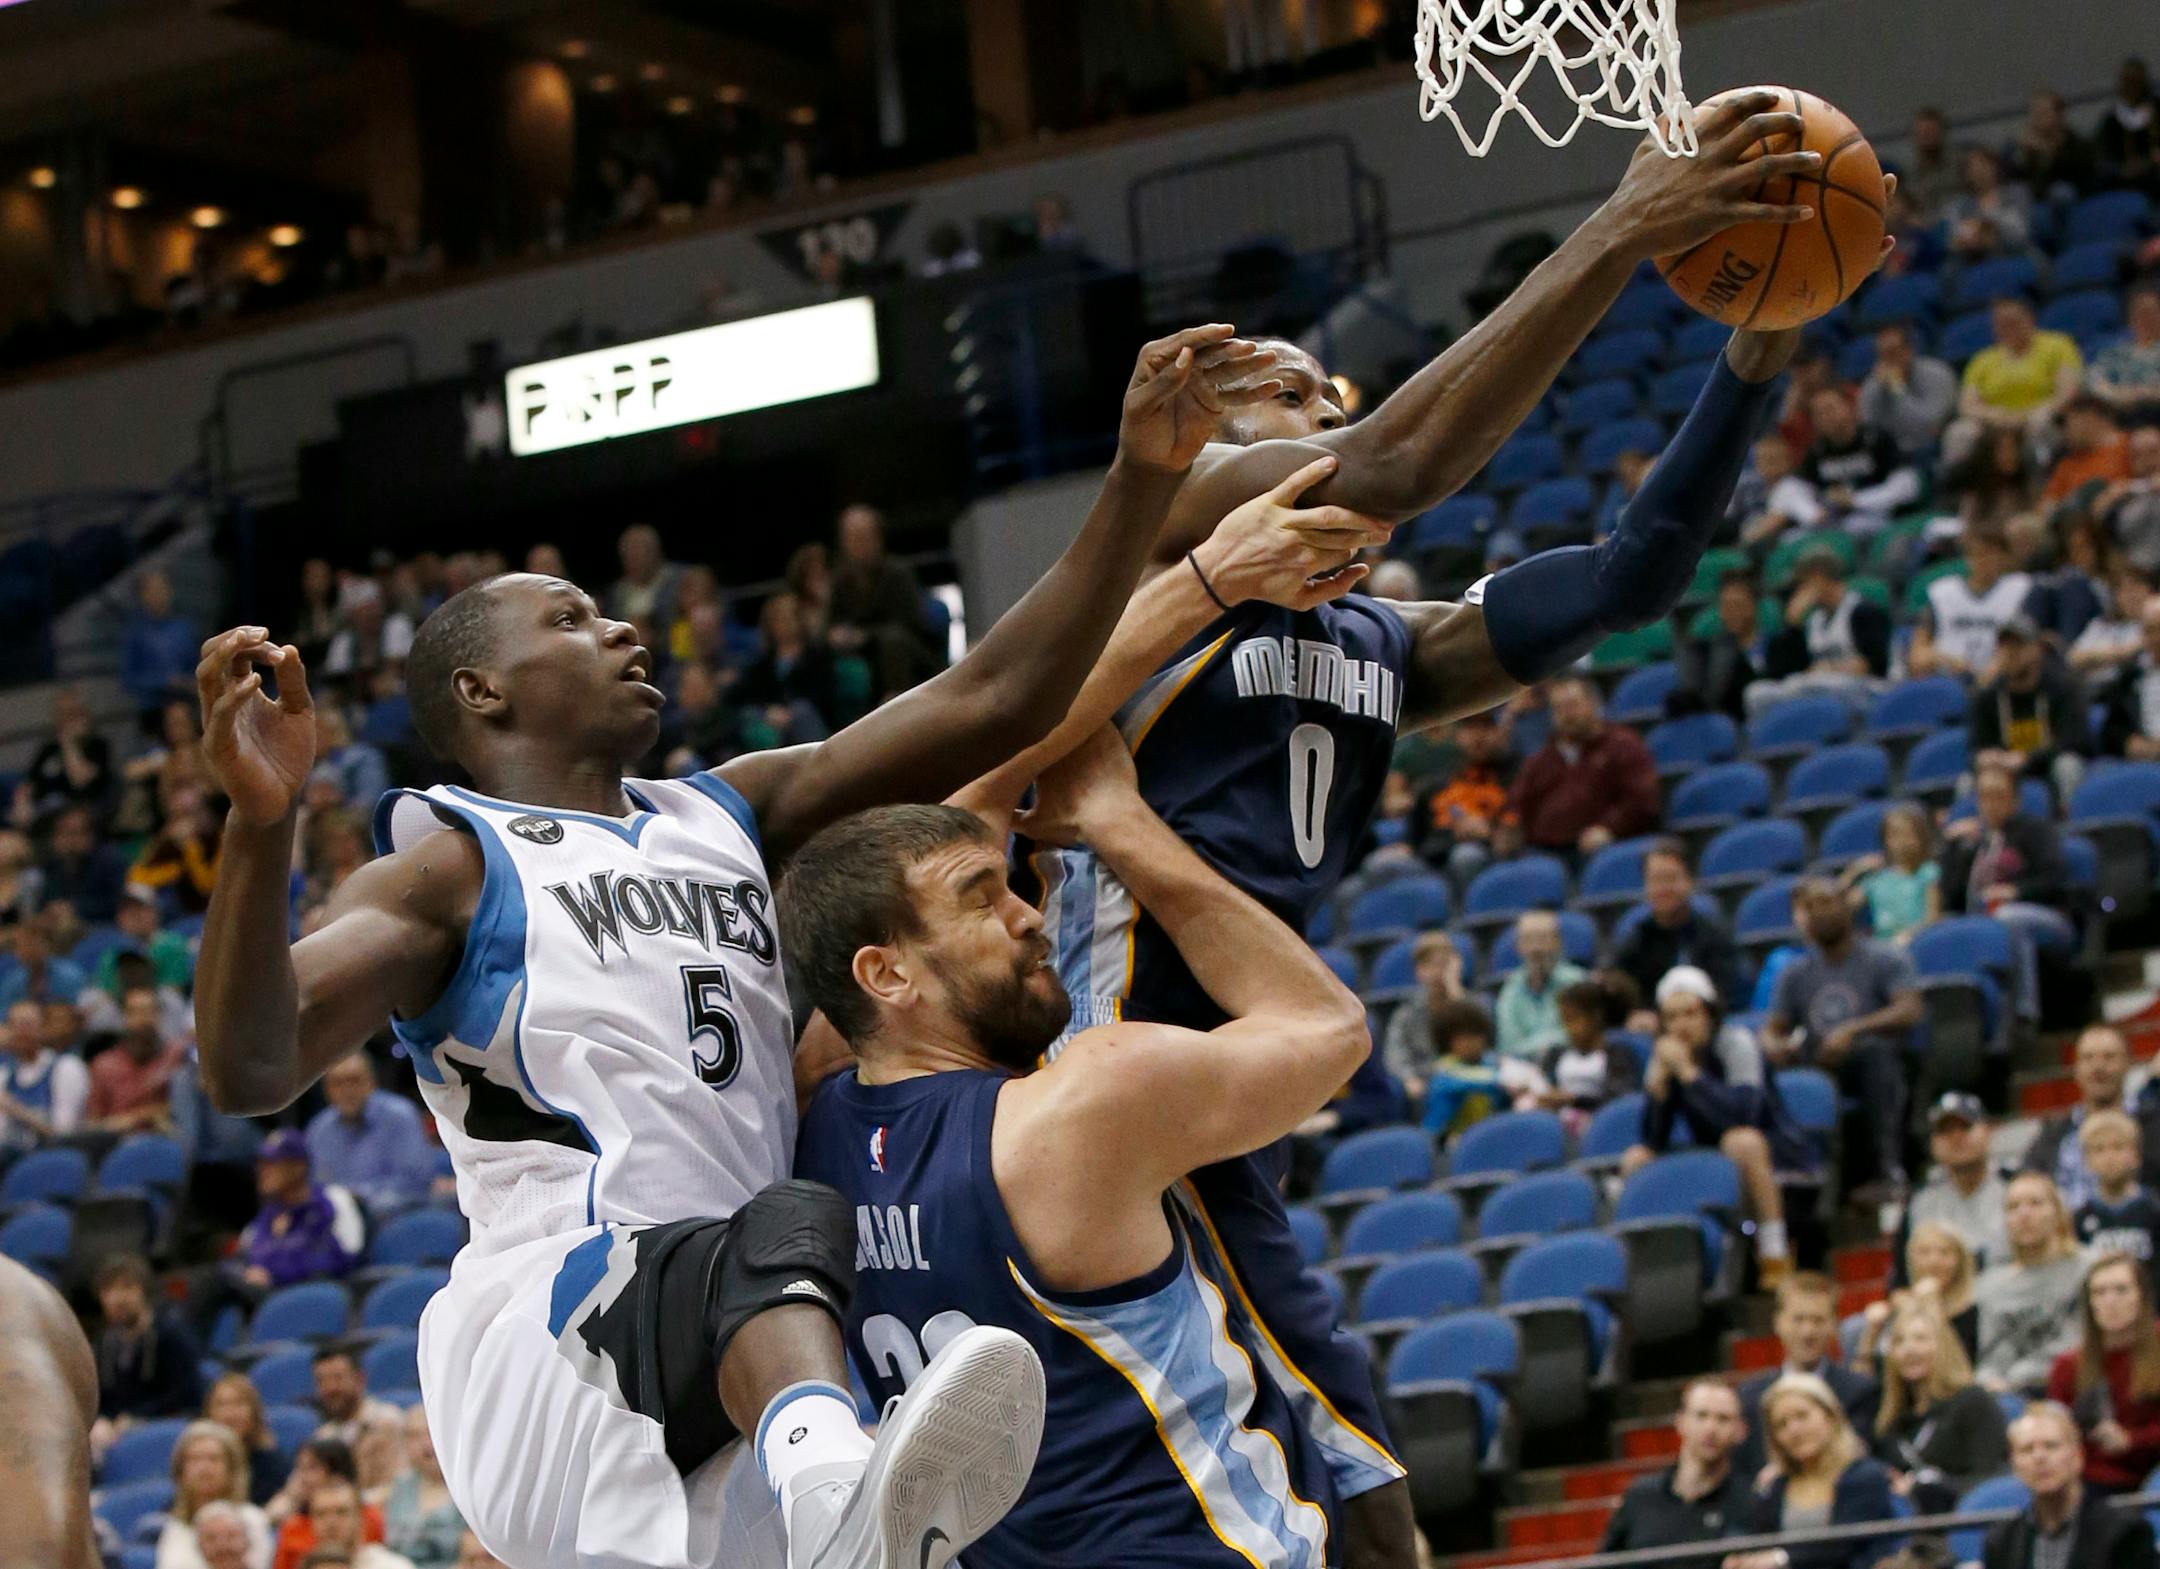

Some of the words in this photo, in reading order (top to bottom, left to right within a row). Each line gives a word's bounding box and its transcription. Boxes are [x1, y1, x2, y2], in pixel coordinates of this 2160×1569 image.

[514, 820, 554, 834] FLIP
[1289, 722, 1335, 868] 0
[542, 869, 777, 966] WOLVES
[680, 964, 743, 1091] 5
